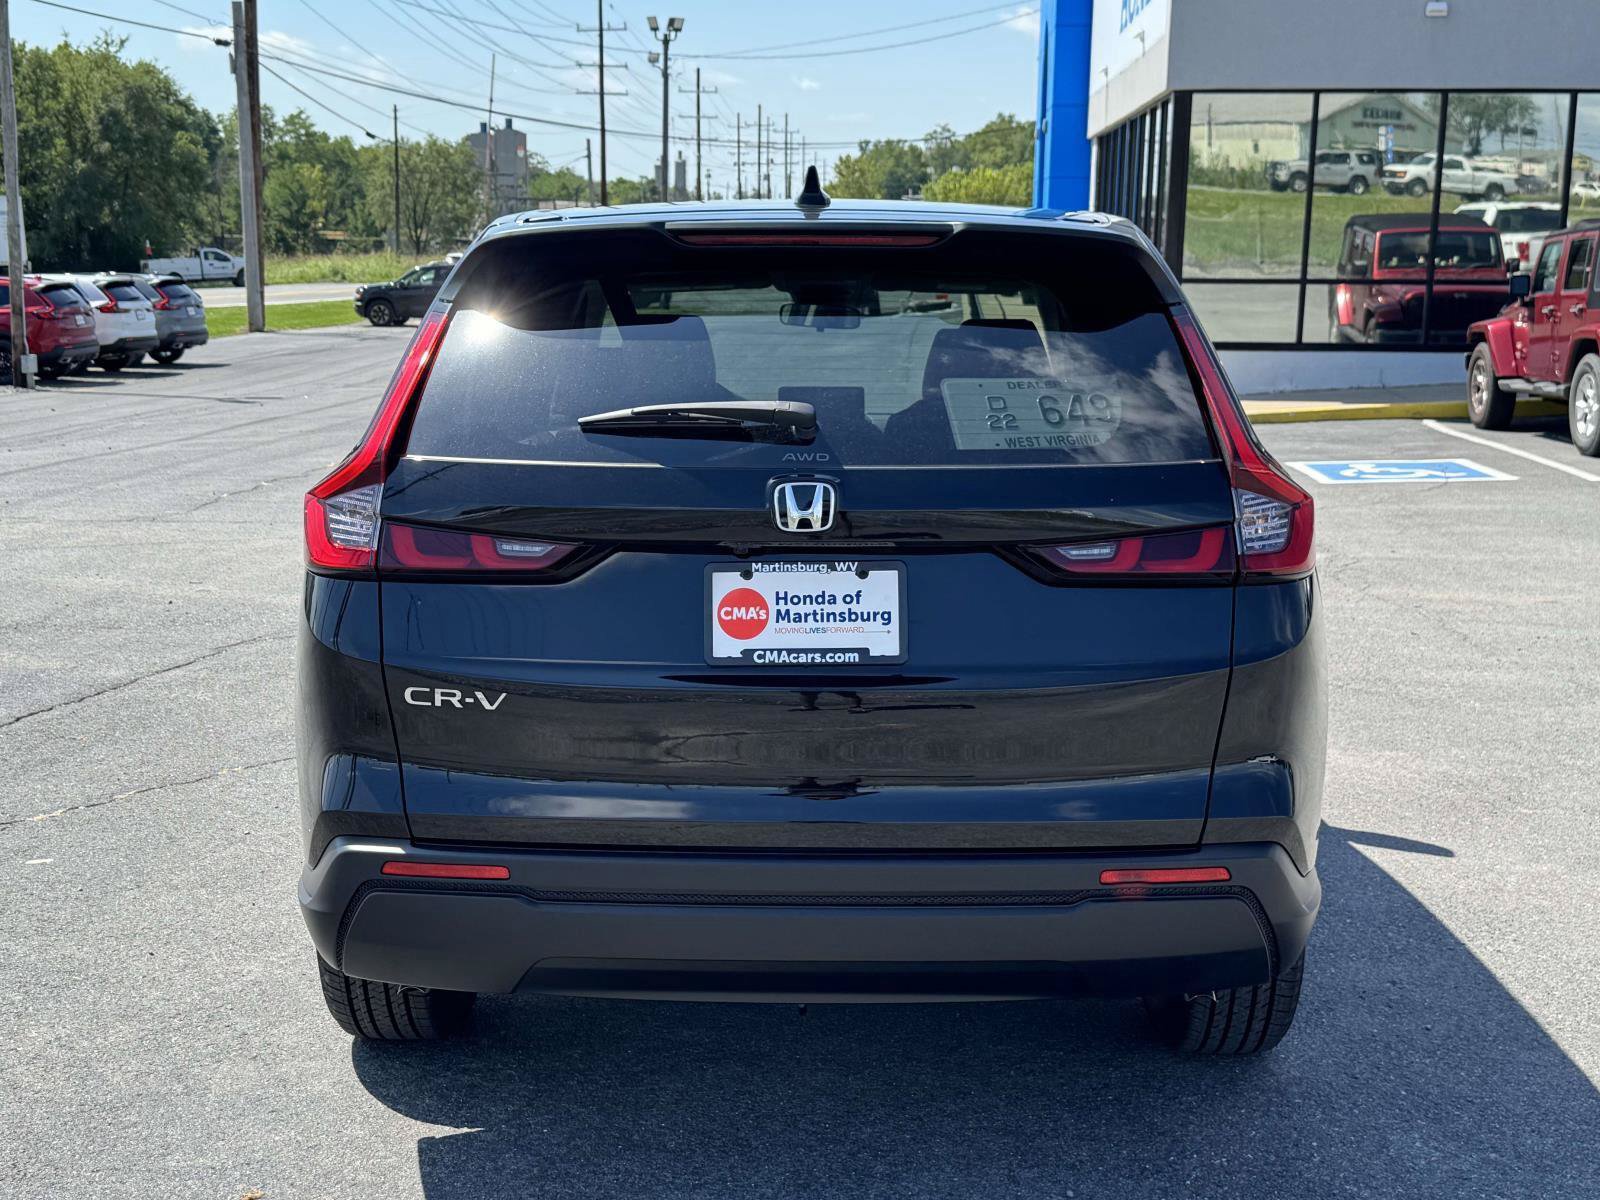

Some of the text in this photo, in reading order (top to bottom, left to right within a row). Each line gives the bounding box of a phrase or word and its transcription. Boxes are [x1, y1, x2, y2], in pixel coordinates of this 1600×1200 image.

[1036, 393, 1112, 427] 649
[985, 413, 1020, 429] 22
[1004, 434, 1100, 449] WEST VIRGINIA
[782, 453, 830, 462] AWD
[751, 562, 859, 574] Martinsburg, WV
[775, 590, 863, 606] Honda of
[720, 606, 767, 621] CMA's
[775, 608, 892, 626] Martinsburg
[753, 650, 859, 664] CMAcars.com
[404, 686, 508, 711] CR-V
